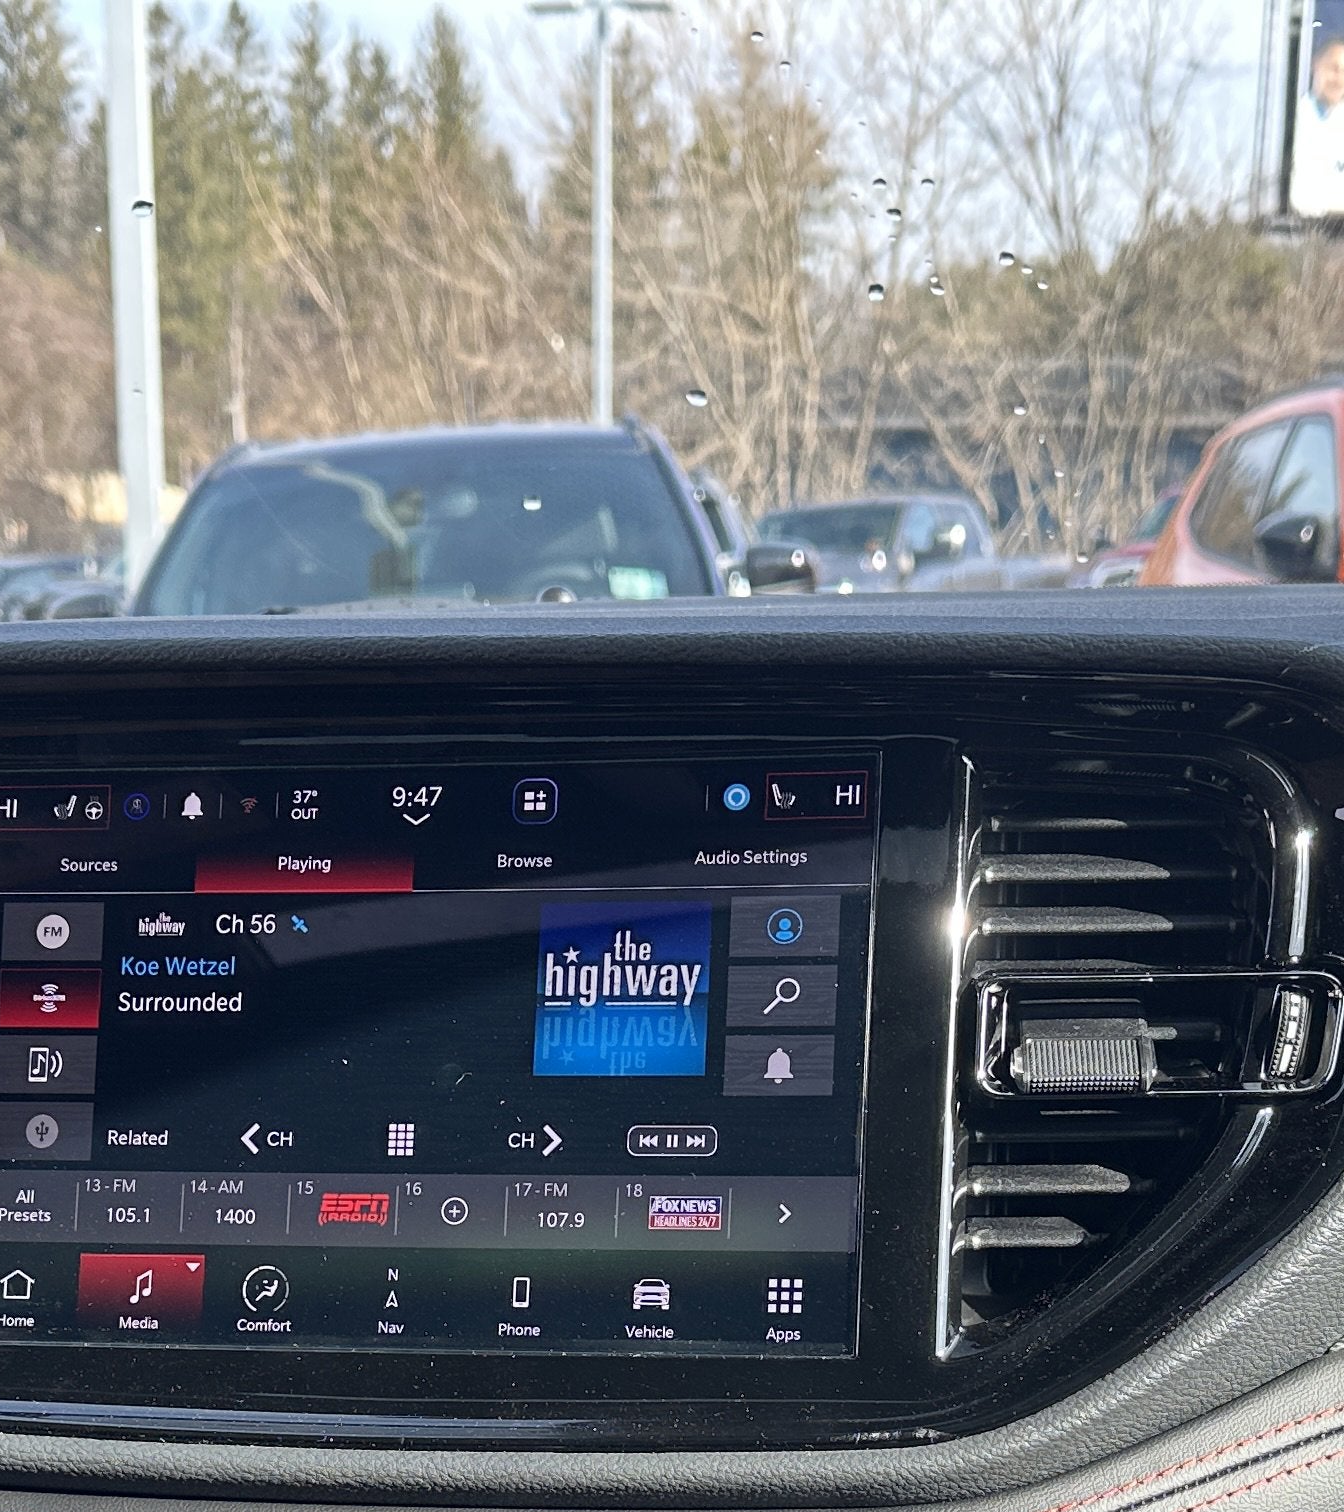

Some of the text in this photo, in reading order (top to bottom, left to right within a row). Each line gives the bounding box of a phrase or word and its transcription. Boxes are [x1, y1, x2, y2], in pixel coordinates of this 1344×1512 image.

[392, 786, 443, 807] 9:47
[835, 785, 861, 805] HI
[291, 808, 319, 820] OUT
[60, 858, 118, 873] Sources
[277, 856, 332, 874] Playing
[497, 853, 553, 868] Browse
[695, 849, 808, 867] Audio Settings
[159, 911, 171, 922] the
[216, 914, 276, 934] Ch 56
[43, 927, 63, 937] FM
[138, 917, 186, 936] highway
[613, 930, 652, 961] the
[121, 956, 236, 976] Koe Wetzel
[544, 947, 702, 1007] highway
[118, 992, 242, 1012] Surrounded
[107, 1130, 169, 1147] Related
[266, 1131, 294, 1147] CH
[507, 1132, 535, 1149] CH
[296, 1181, 314, 1195] 15
[405, 1182, 422, 1195] 16
[626, 1184, 643, 1197] 18
[15, 1190, 35, 1205] All
[320, 1193, 390, 1212] ESPN
[654, 1199, 717, 1213] FOX NEWS
[106, 1208, 152, 1224] 105.1
[215, 1208, 256, 1224] 1400
[327, 1213, 380, 1223] RADIO
[537, 1212, 585, 1228] 107.9
[698, 1215, 717, 1227] 24/7
[387, 1268, 399, 1281] N
[119, 1316, 159, 1330] Media
[236, 1318, 292, 1333] Comfort
[377, 1321, 404, 1334] Nav
[498, 1323, 541, 1337] Phone
[625, 1325, 674, 1339] Vehicle
[765, 1327, 801, 1342] Apps
